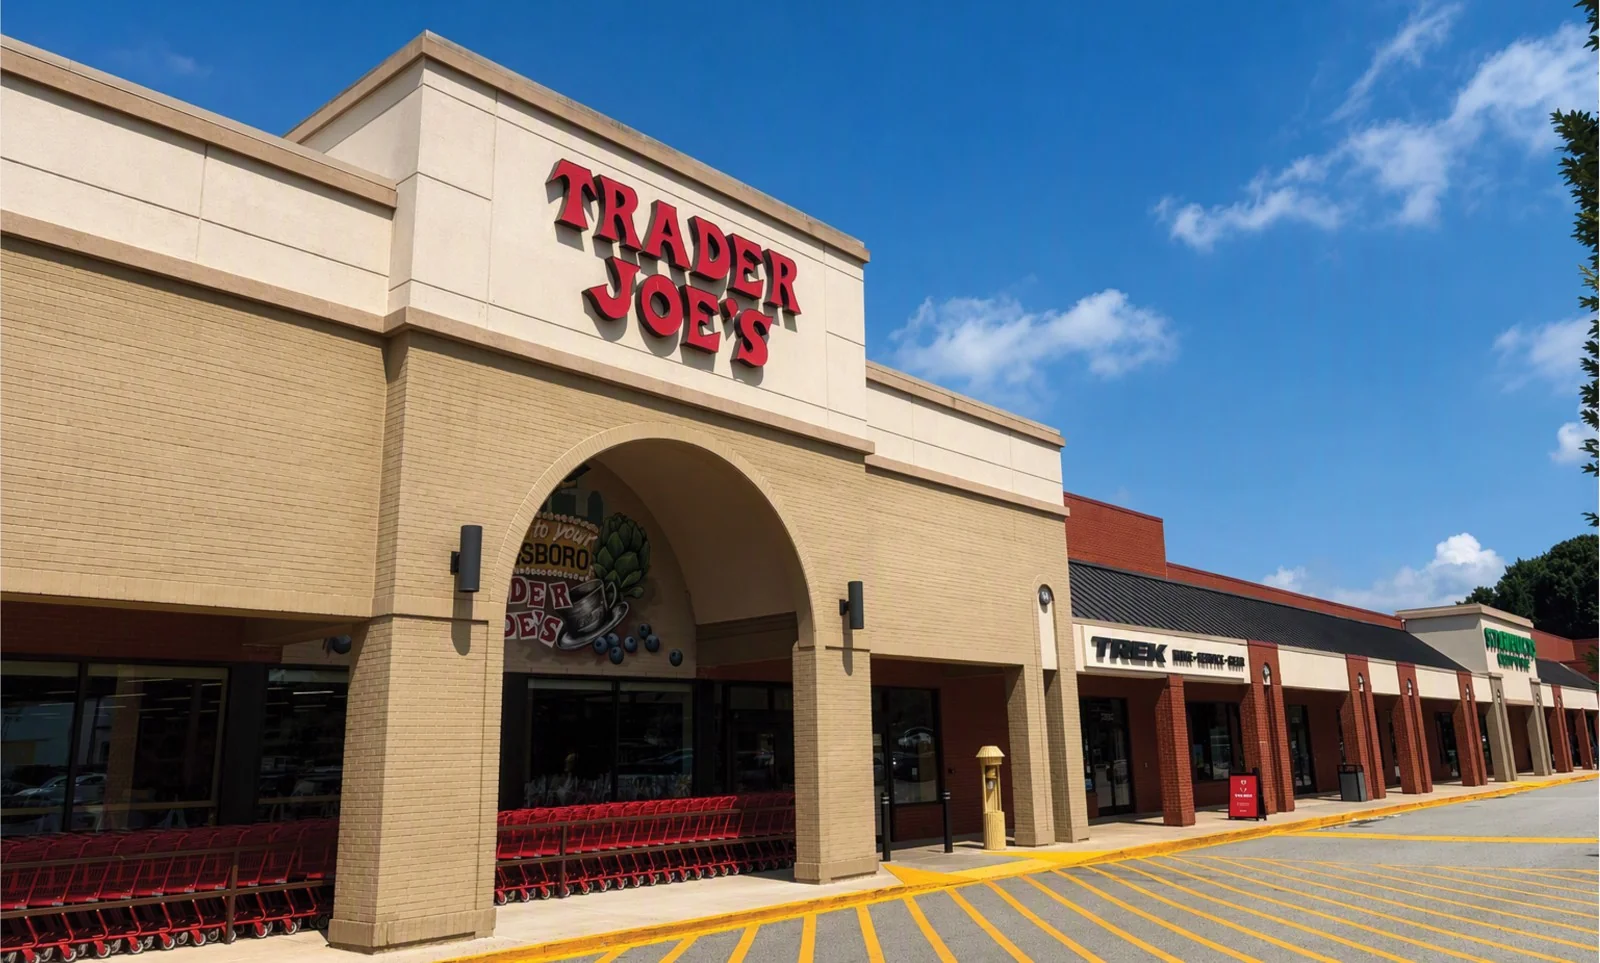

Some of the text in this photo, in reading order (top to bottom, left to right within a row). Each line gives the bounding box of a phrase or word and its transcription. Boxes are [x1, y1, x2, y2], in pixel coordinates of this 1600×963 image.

[546, 158, 802, 315] TRADER
[581, 256, 774, 368] JOE'S
[532, 519, 599, 549] to your
[515, 543, 590, 571] SBORO
[1091, 636, 1168, 664] TREK
